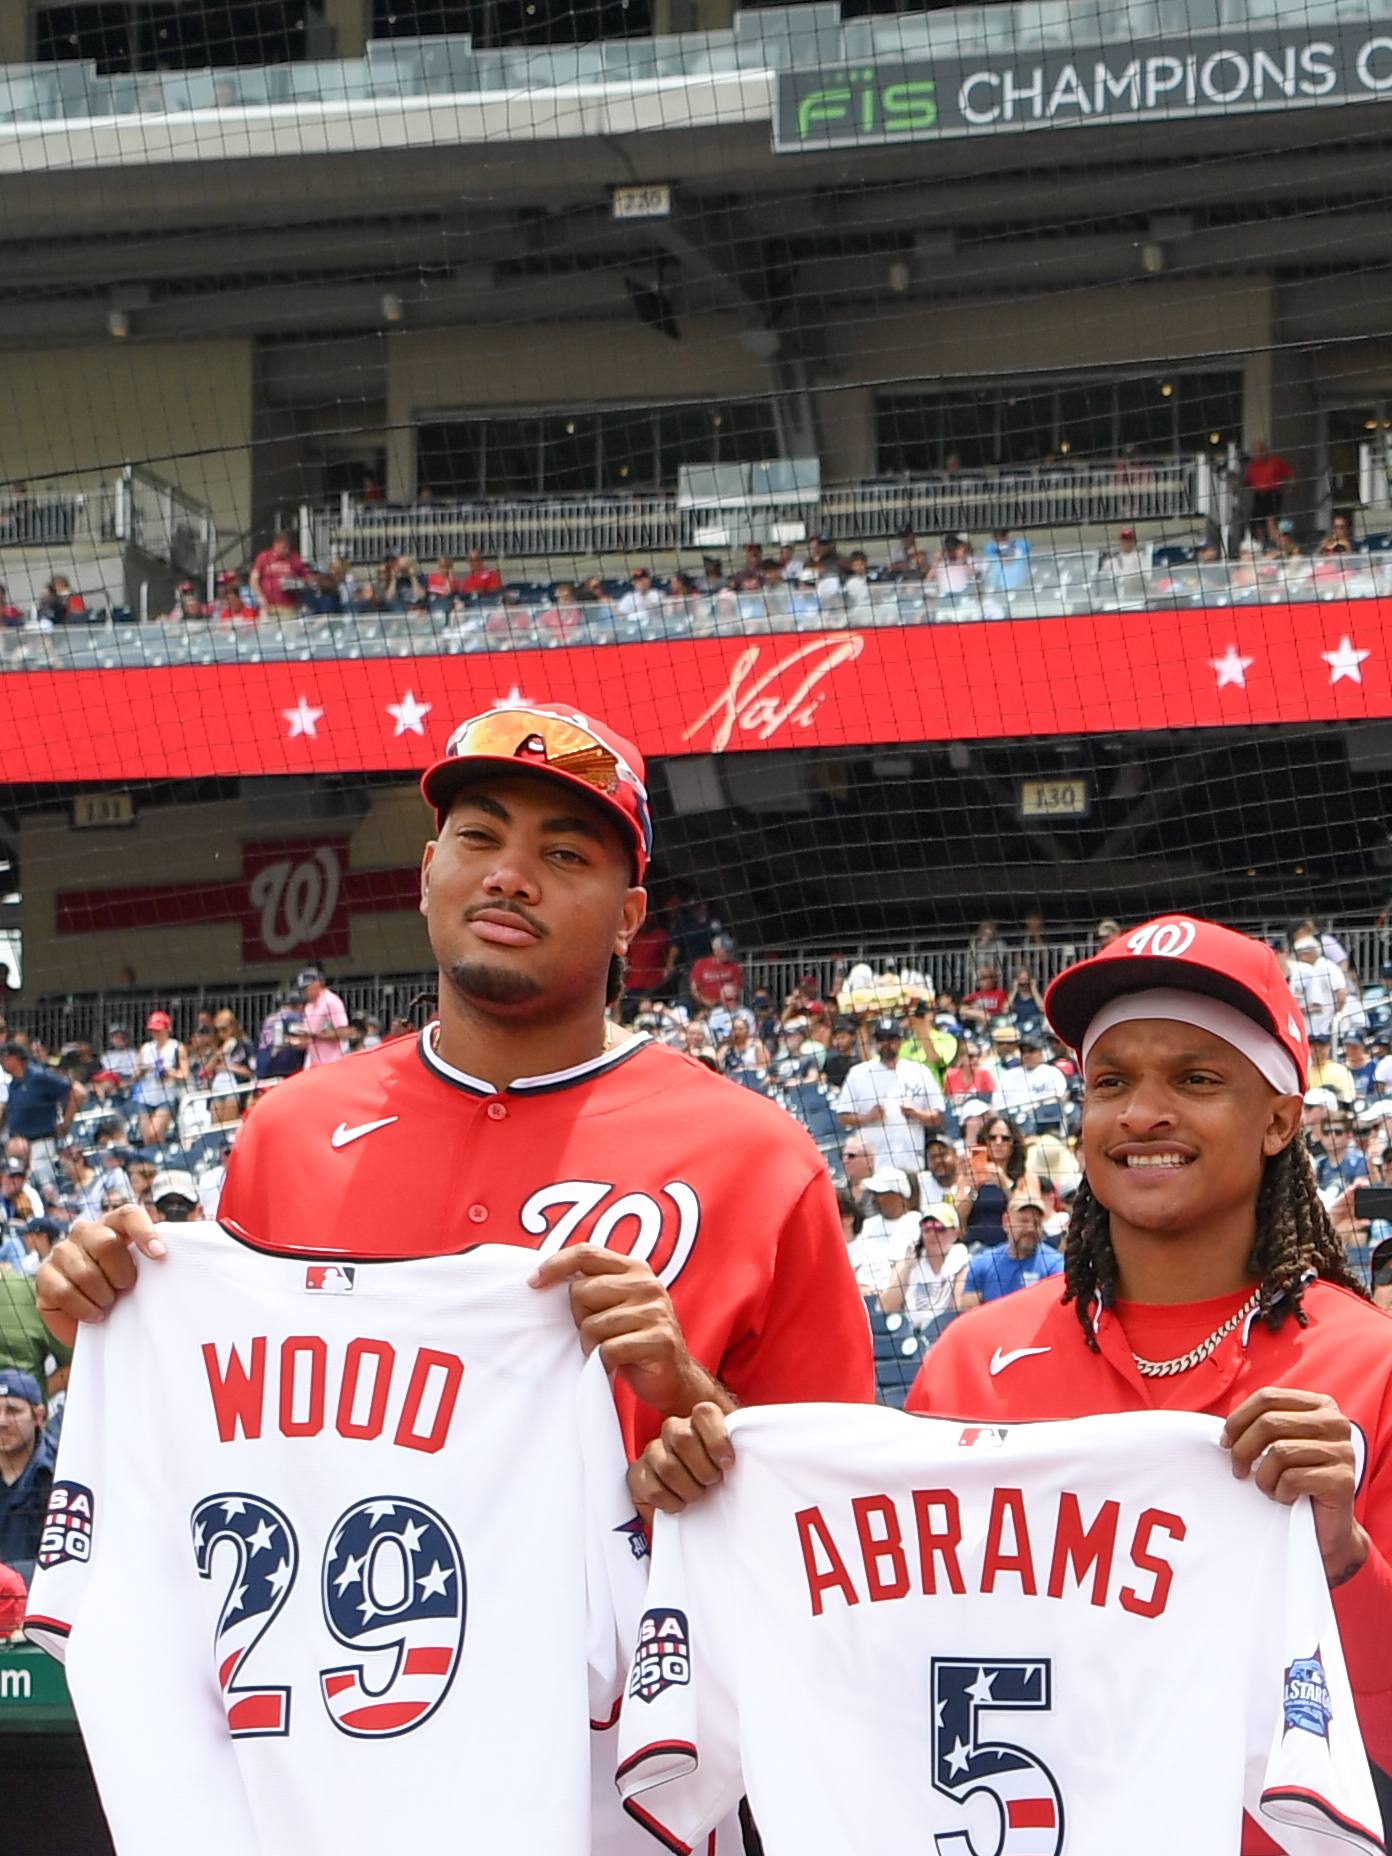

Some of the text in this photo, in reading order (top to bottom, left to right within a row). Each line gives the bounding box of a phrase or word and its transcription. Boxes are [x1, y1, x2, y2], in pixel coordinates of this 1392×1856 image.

[958, 42, 1337, 124] CHAMPIONS
[1037, 787, 1075, 808] 130
[249, 845, 340, 955] W
[201, 1335, 465, 1455] WOOD
[48, 1488, 91, 1518] SA
[40, 1528, 91, 1561] 50
[795, 1487, 1187, 1619] ABRAMS
[190, 1491, 468, 1740] 29
[641, 1617, 685, 1642] SA
